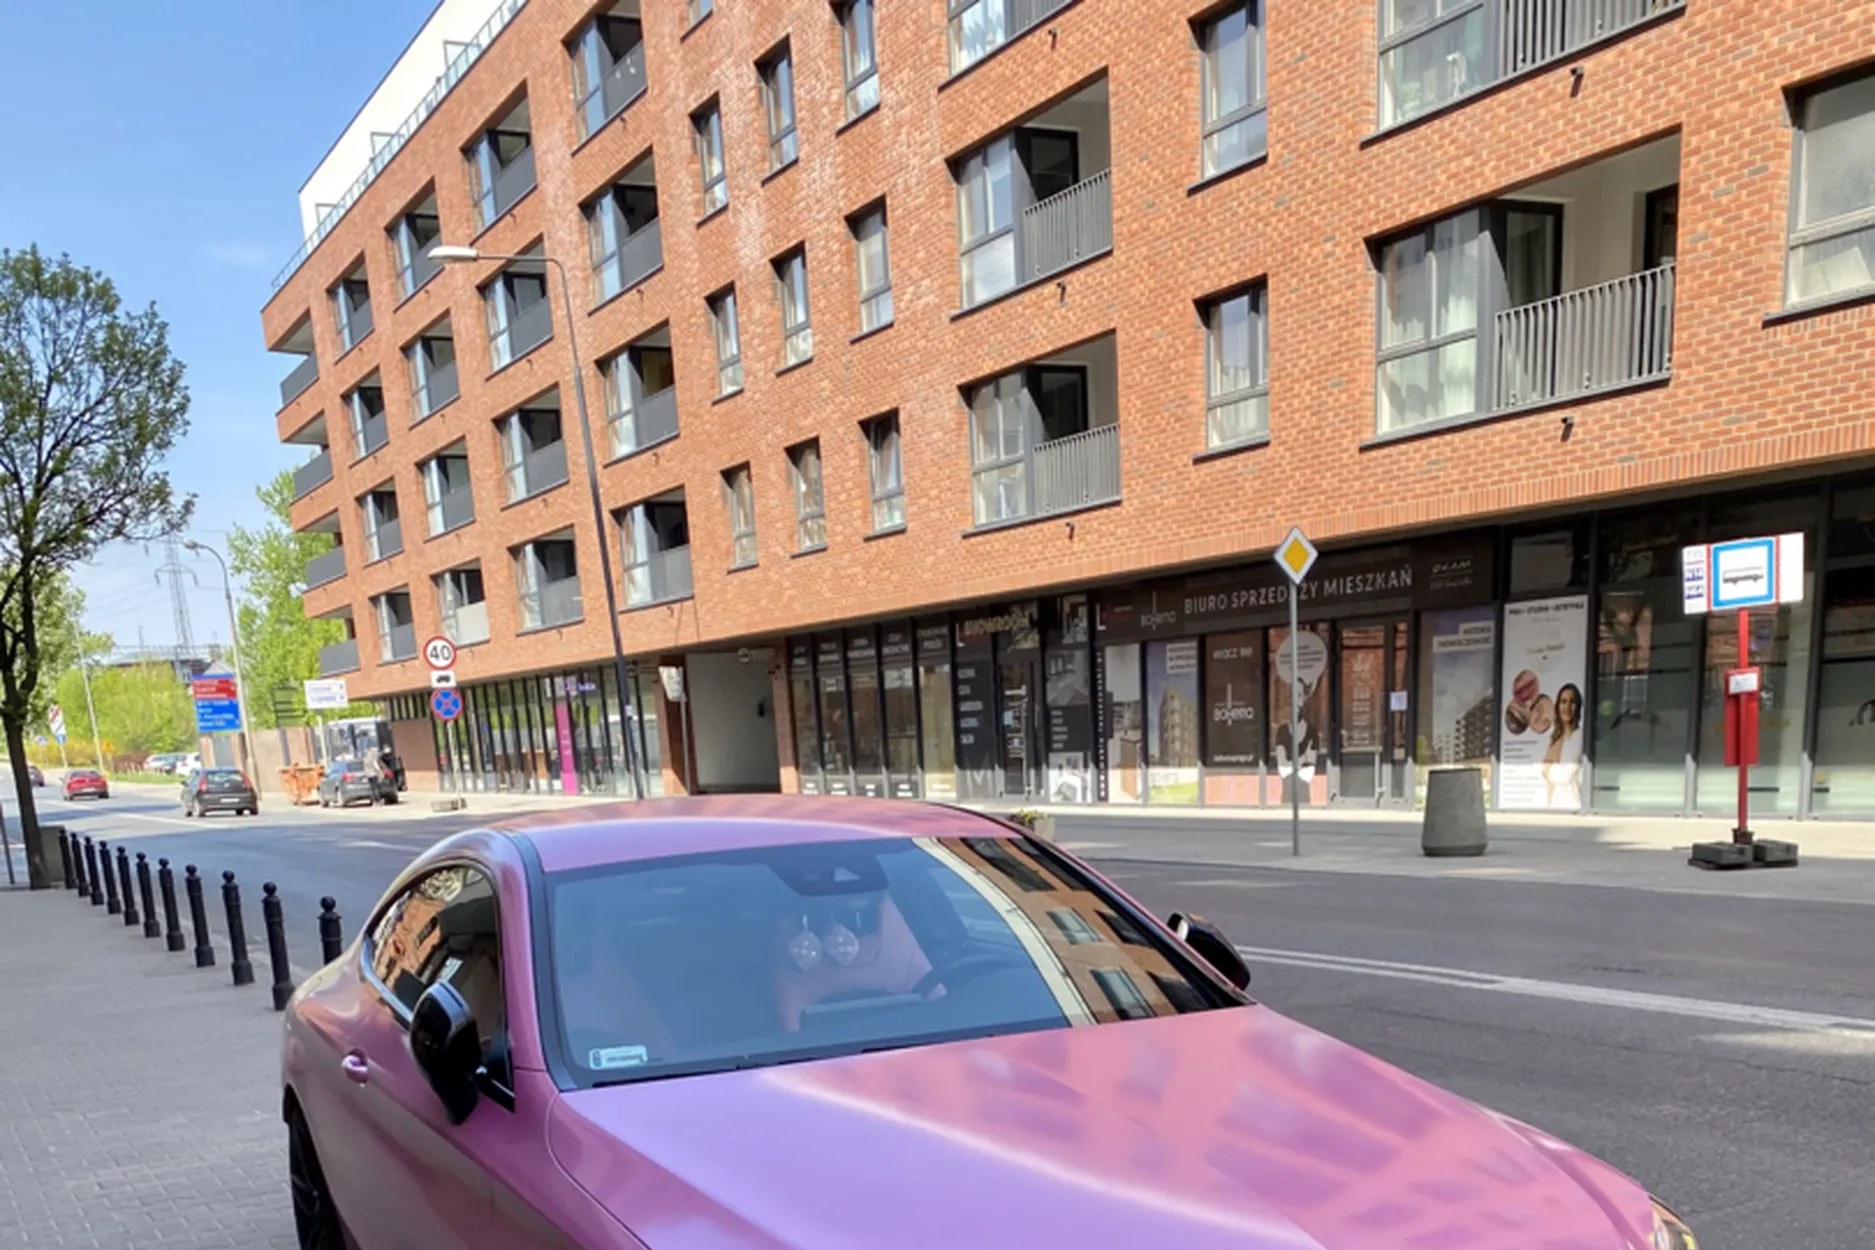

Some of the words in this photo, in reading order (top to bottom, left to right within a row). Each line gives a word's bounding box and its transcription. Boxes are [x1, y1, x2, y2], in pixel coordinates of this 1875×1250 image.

[1184, 594, 1227, 614] BIURO
[1232, 579, 1319, 608] SPRZEDŻY
[1323, 563, 1412, 597] MIESZKAŃ
[430, 644, 452, 661] 40
